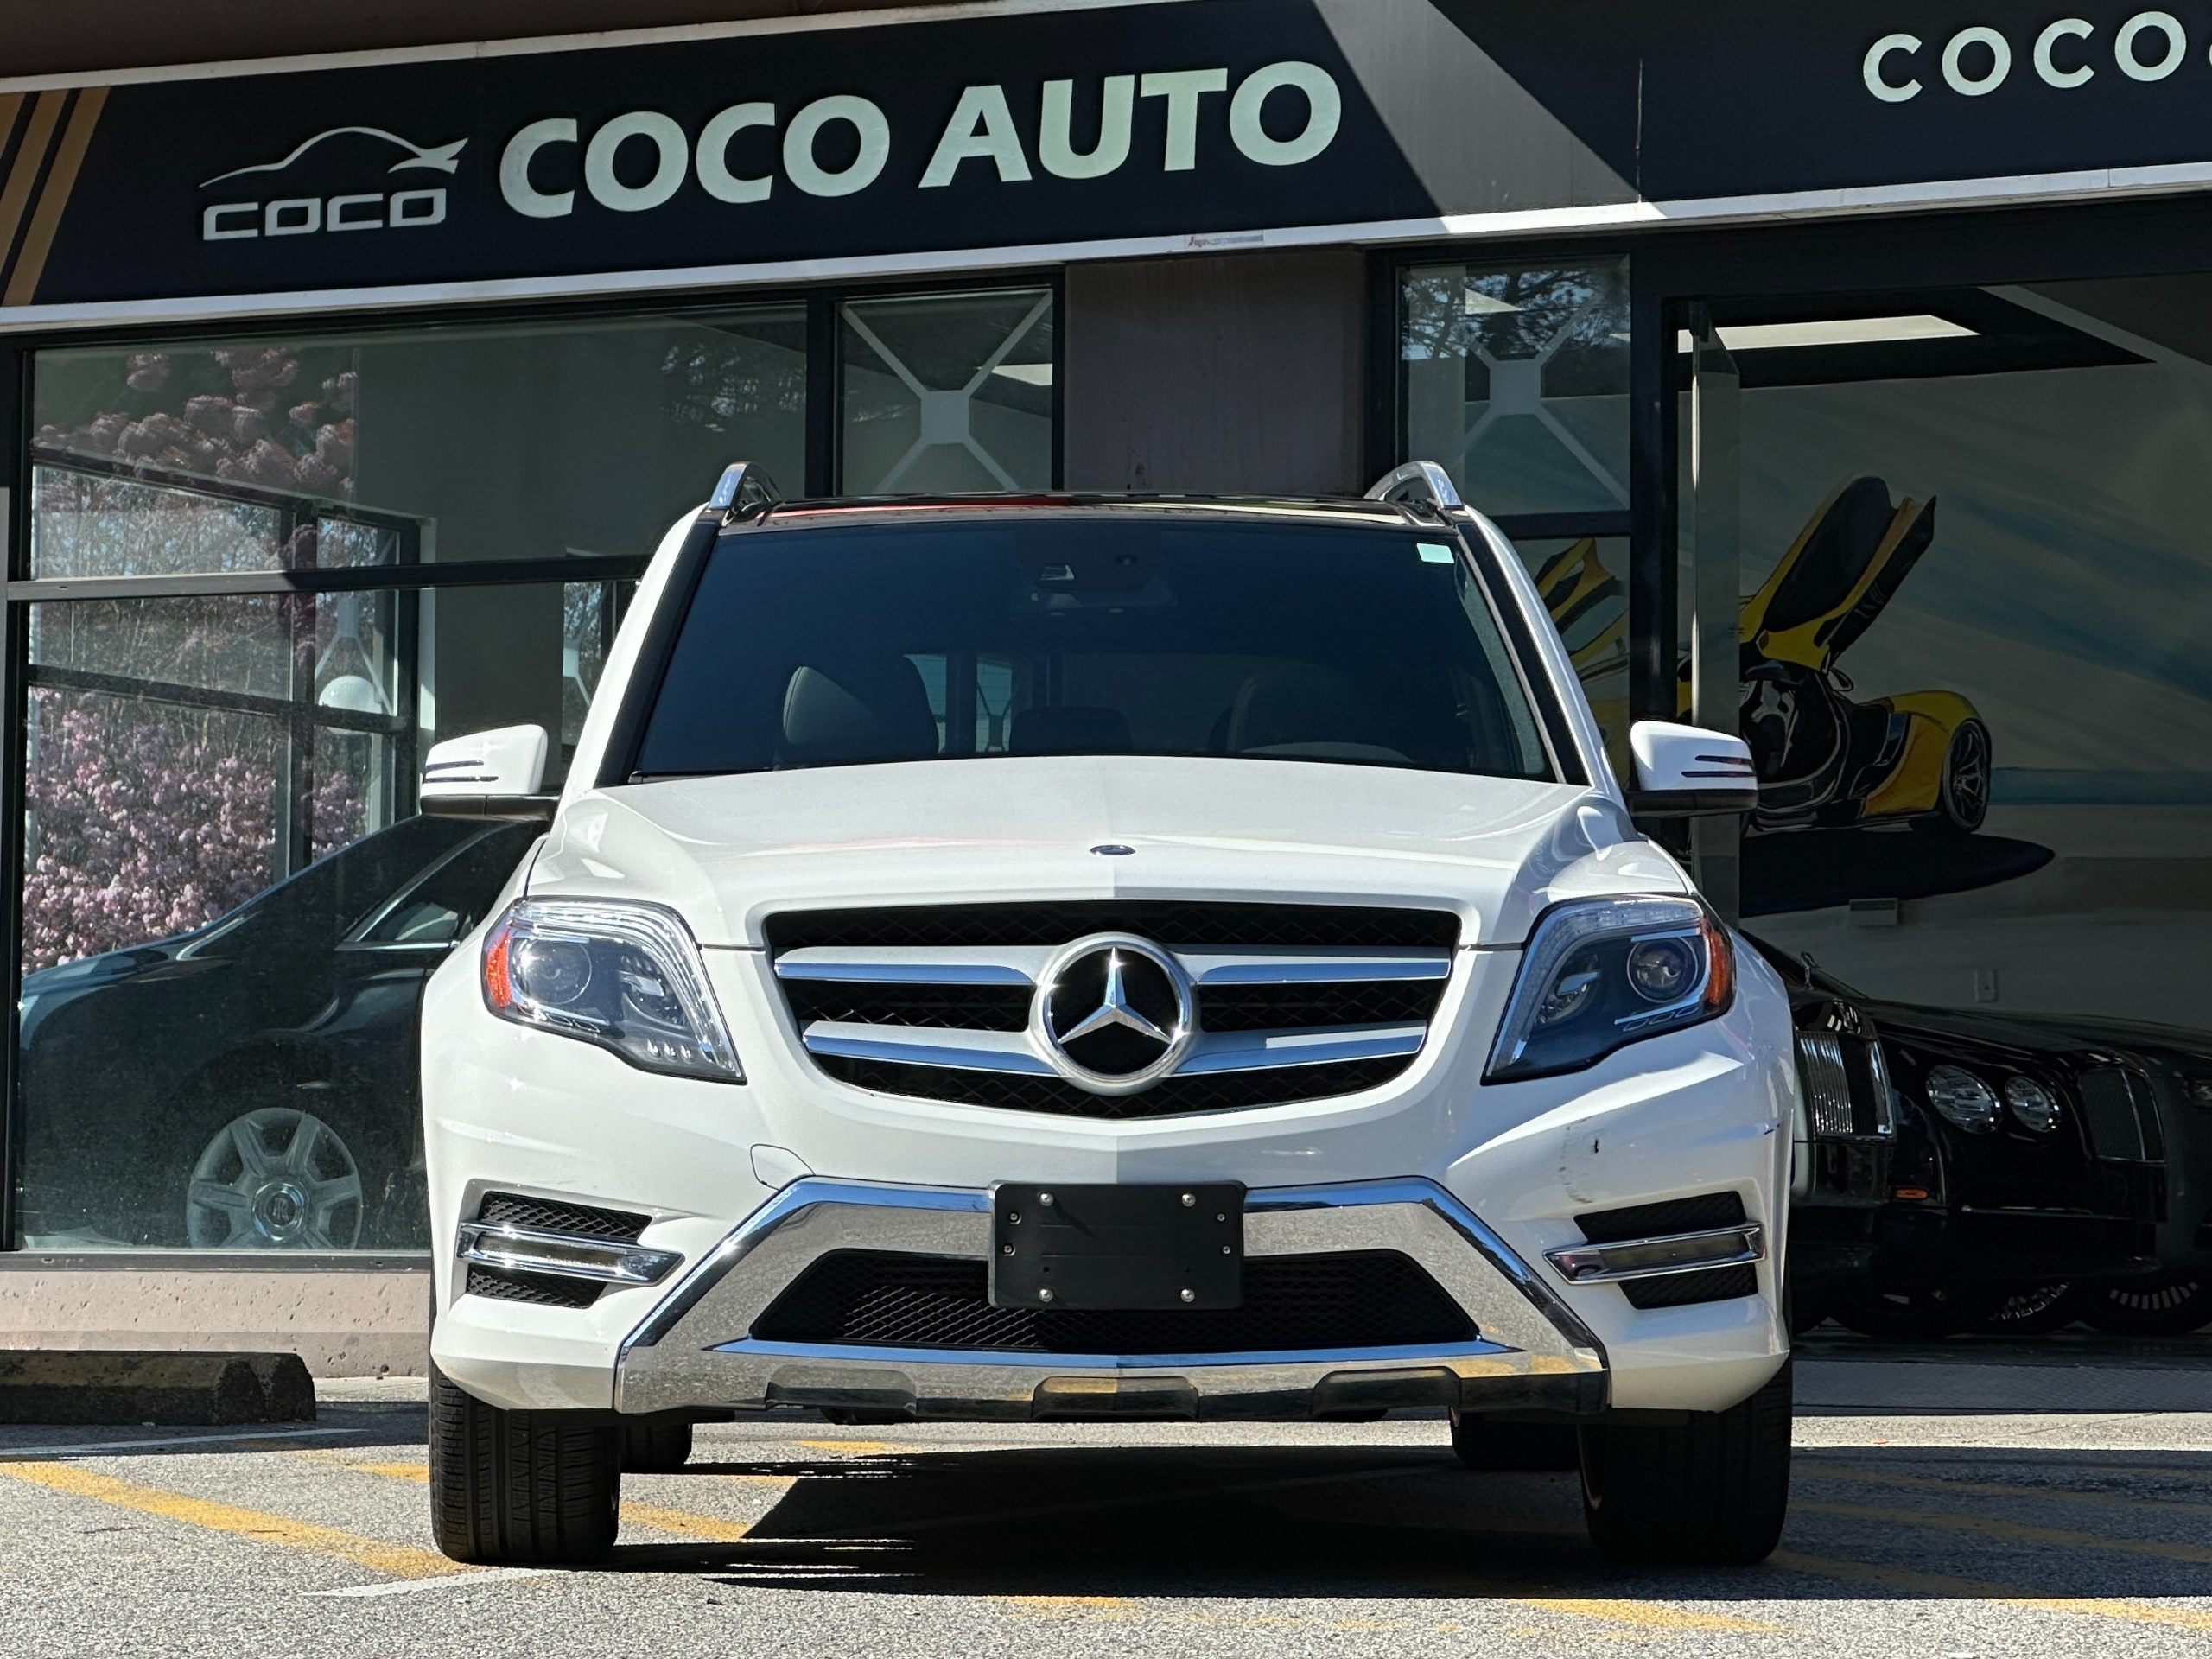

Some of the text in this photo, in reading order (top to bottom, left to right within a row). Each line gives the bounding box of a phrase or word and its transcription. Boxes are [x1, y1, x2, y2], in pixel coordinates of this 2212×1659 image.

[1862, 10, 2212, 103] COCO
[499, 60, 1342, 218] COCO AUTO
[203, 188, 447, 240] COCO
